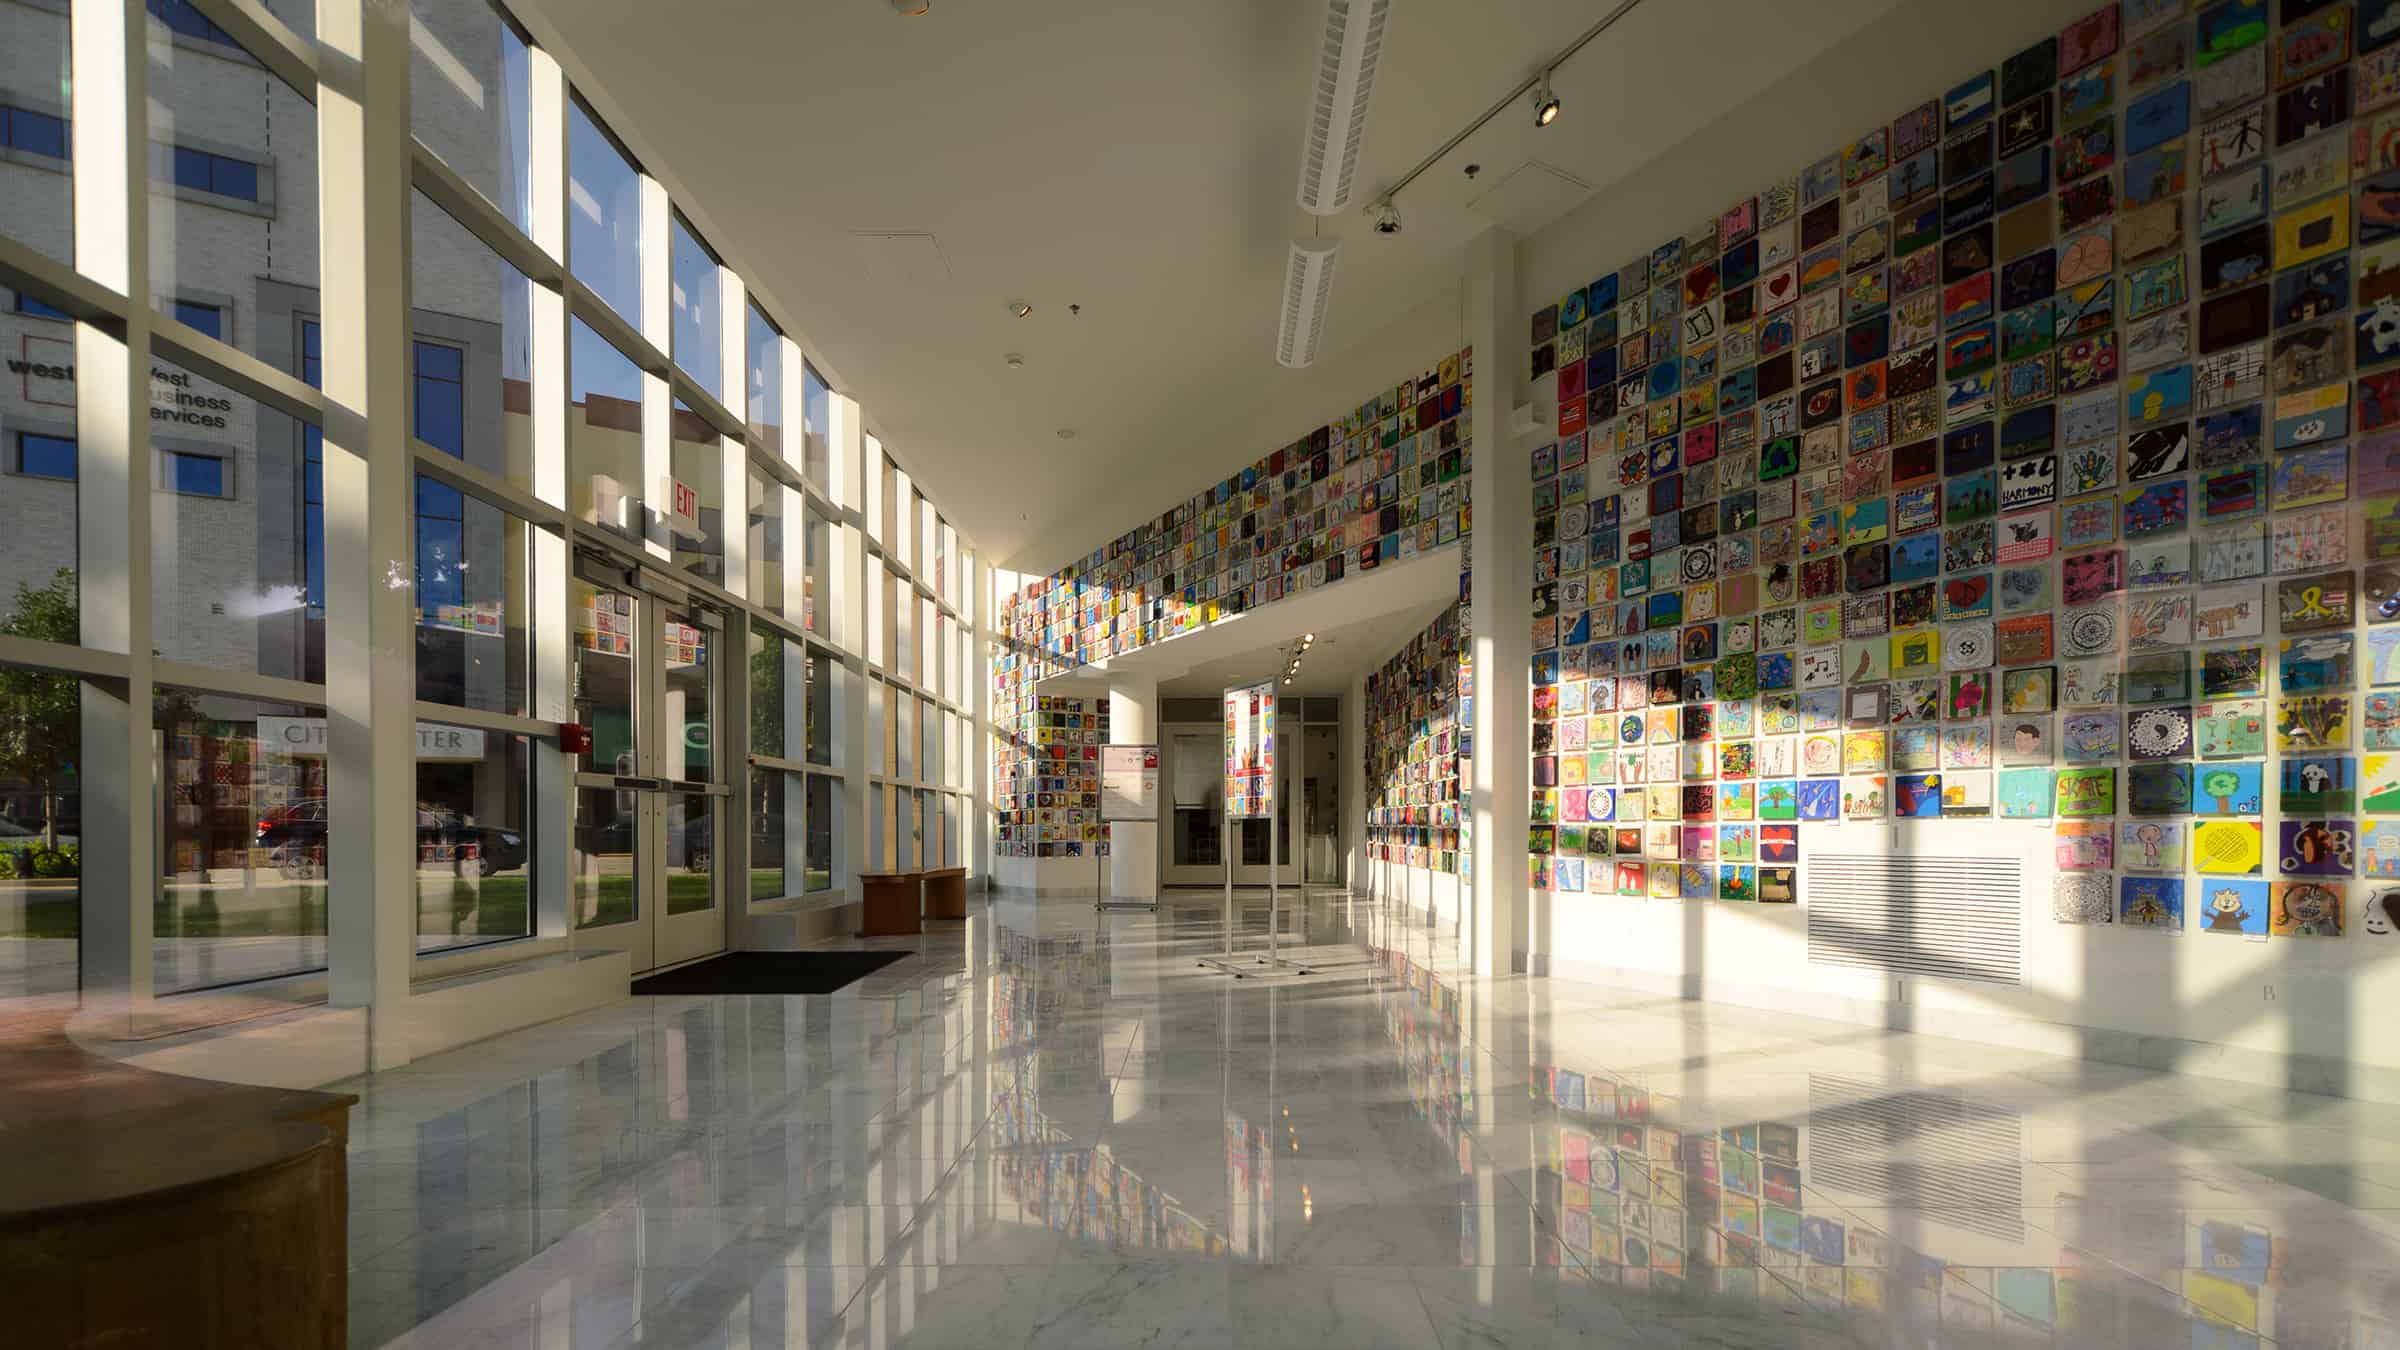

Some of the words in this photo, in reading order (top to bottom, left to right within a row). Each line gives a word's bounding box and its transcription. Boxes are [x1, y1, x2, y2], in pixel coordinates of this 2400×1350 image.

[151, 407, 225, 428] ervices
[676, 482, 696, 520] EXIT
[2002, 481, 2055, 502] HARMONY
[284, 725, 328, 744] CIT
